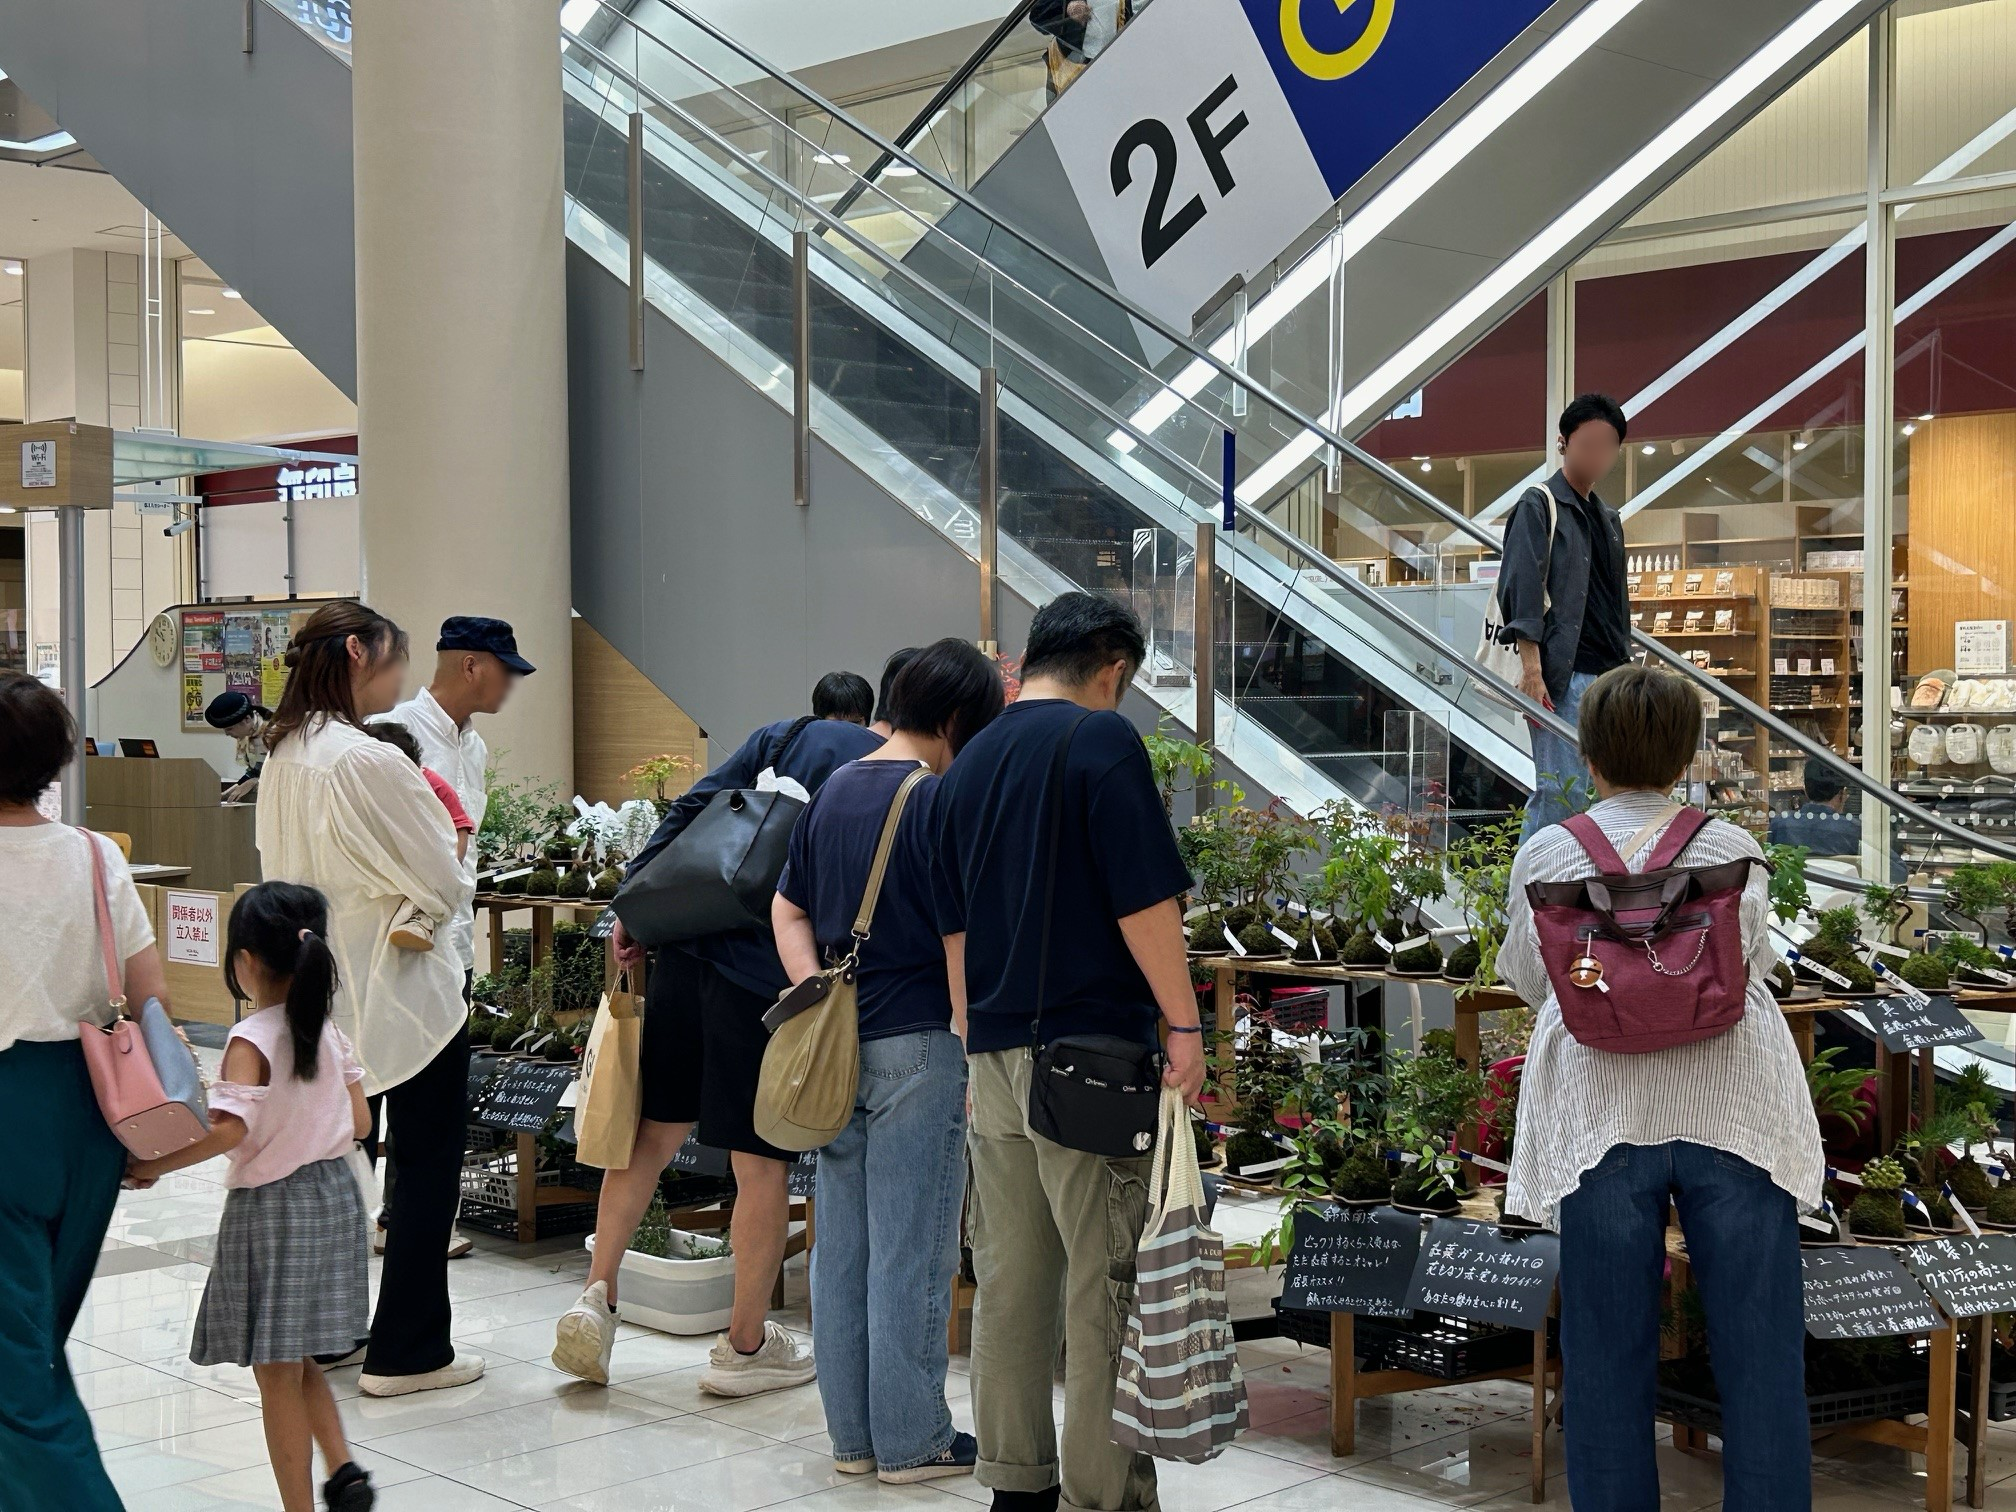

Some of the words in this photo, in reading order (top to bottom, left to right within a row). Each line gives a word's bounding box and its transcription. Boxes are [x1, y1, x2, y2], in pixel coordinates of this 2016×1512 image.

[1110, 73, 1249, 270] 2F
[172, 904, 213, 923] 関係者以外
[176, 924, 209, 942] 立入禁止
